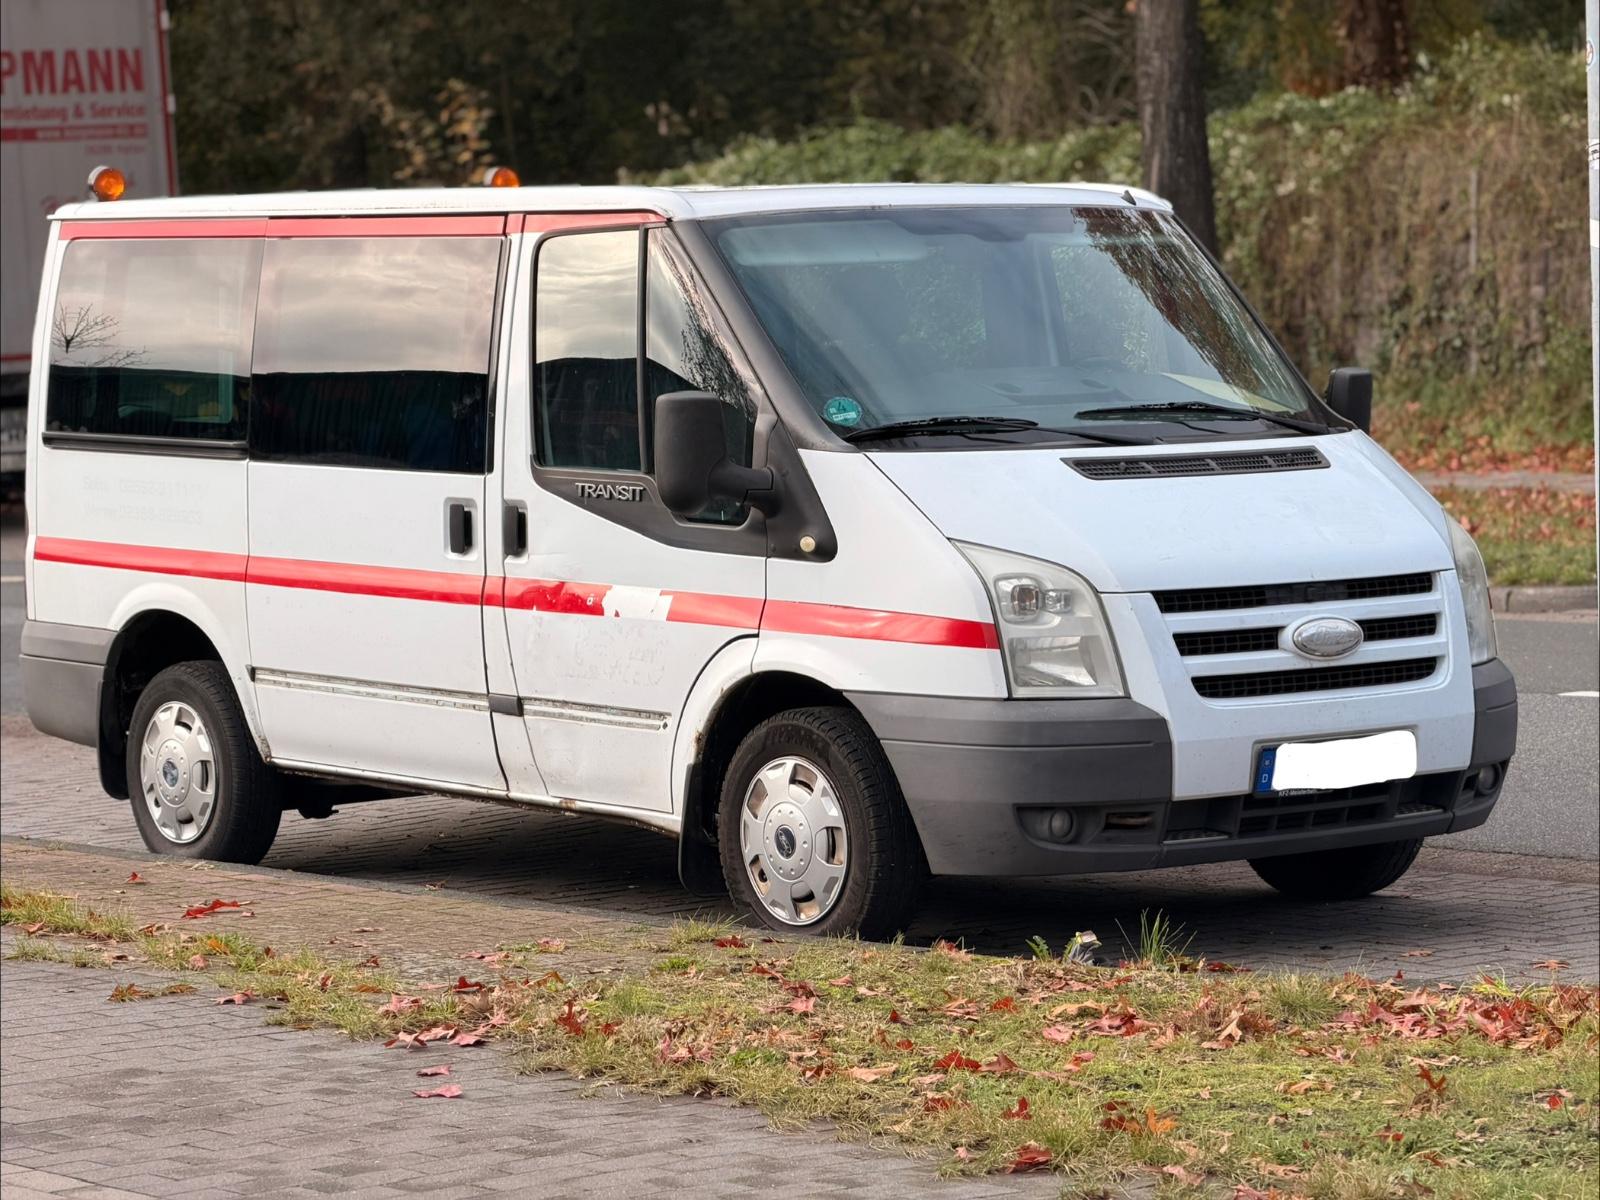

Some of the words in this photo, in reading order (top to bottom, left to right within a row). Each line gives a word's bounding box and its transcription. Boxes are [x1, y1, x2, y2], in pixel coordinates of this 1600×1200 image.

[91, 101, 145, 118] Service
[575, 482, 644, 501] TRANSIT
[1261, 773, 1270, 783] D
